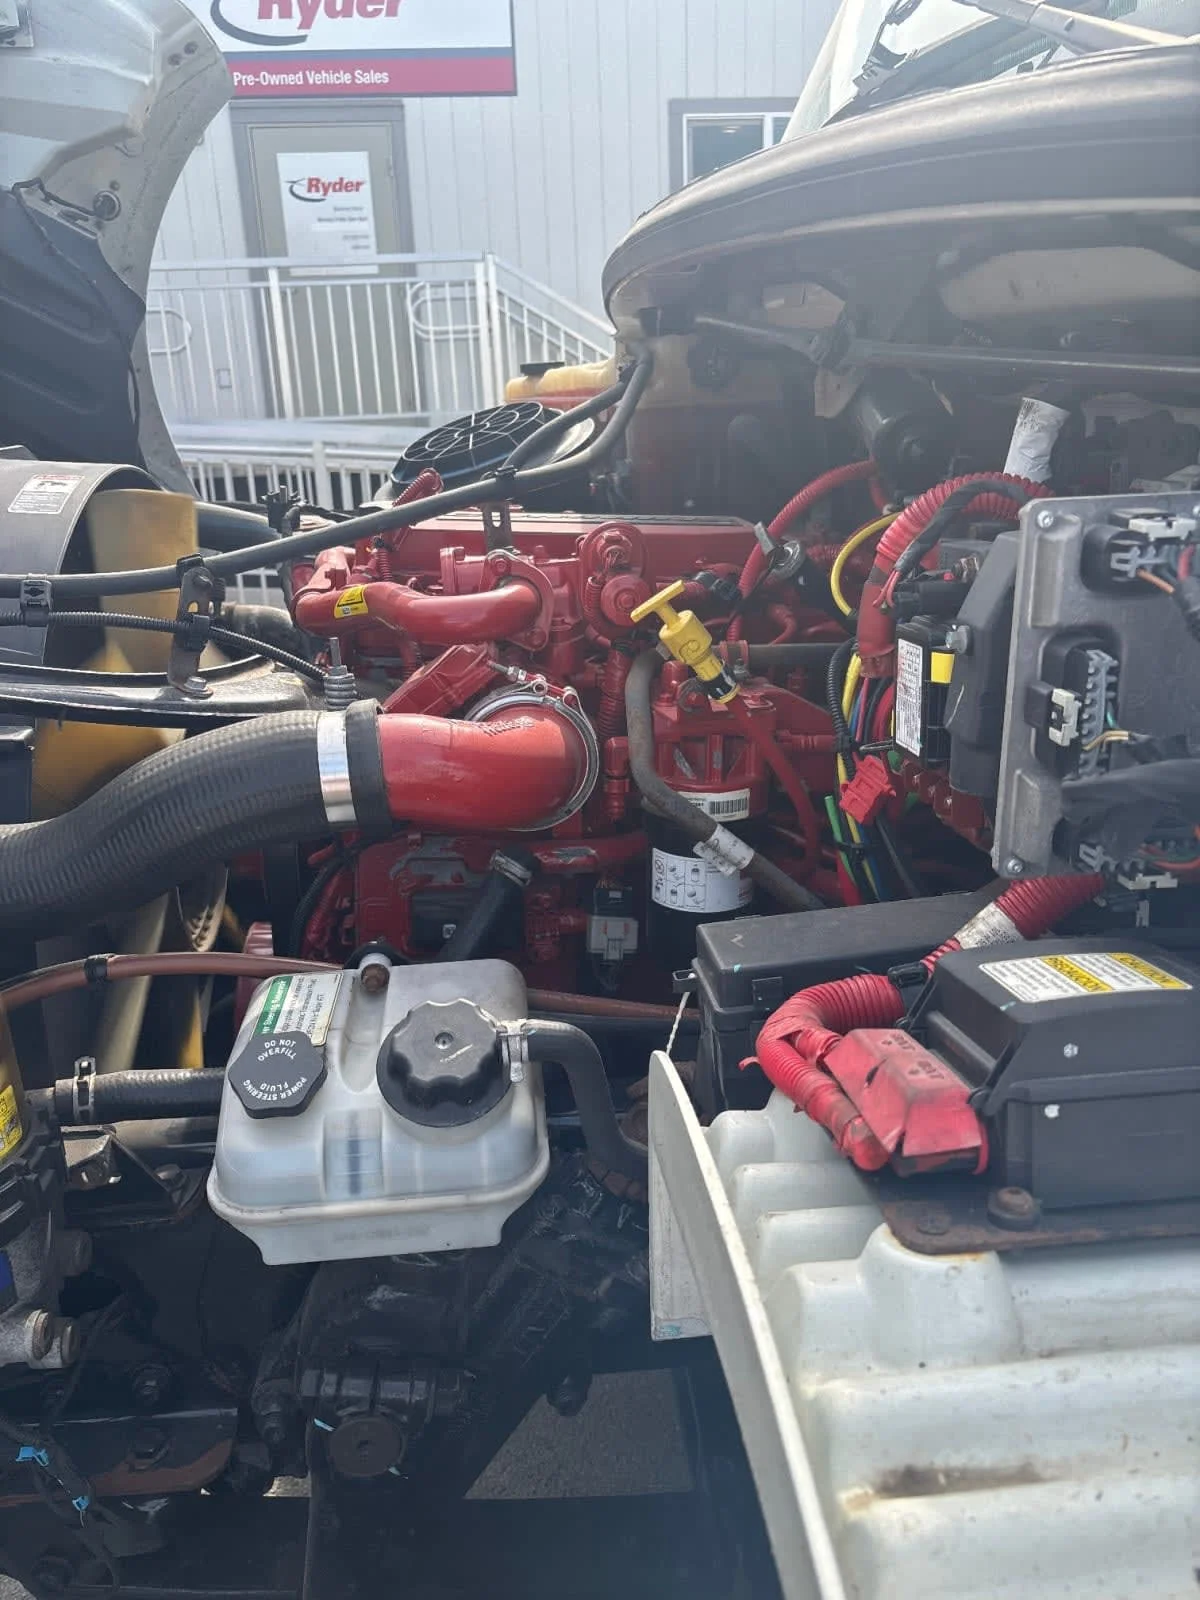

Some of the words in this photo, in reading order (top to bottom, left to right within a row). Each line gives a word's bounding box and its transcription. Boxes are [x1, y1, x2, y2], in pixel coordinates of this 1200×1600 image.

[233, 71, 304, 86] Pre-Owned
[306, 69, 351, 85] Vehicle
[354, 69, 390, 84] Sales
[306, 176, 366, 197] Ryder
[264, 1039, 276, 1049] DO
[279, 1039, 297, 1048] NOT
[257, 1047, 297, 1061] OVERFILL
[243, 1079, 278, 1101] STEERING
[260, 1081, 289, 1092] FLUID
[280, 1077, 308, 1099] POWER
